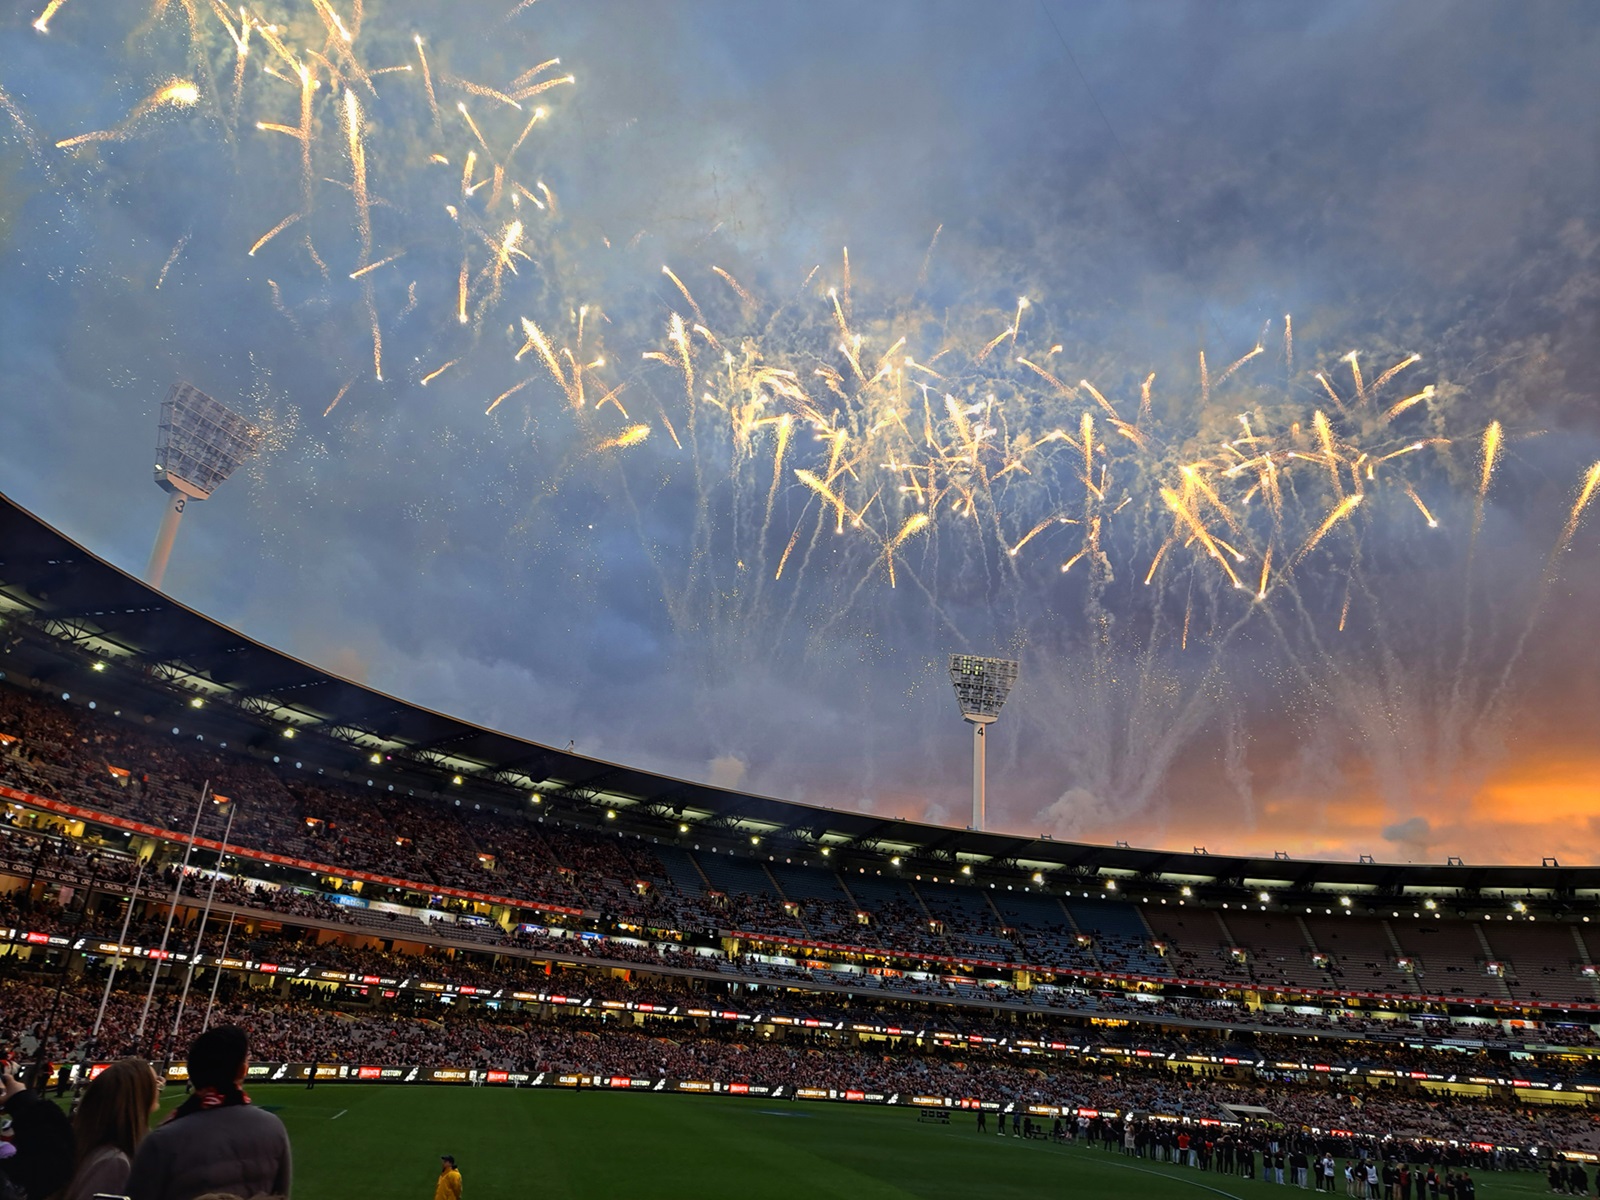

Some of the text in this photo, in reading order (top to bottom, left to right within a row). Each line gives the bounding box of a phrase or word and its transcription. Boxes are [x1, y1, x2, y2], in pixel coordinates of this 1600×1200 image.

[175, 500, 185, 513] 3
[977, 727, 984, 736] 4
[617, 916, 704, 934] SHANE WARNE STAND
